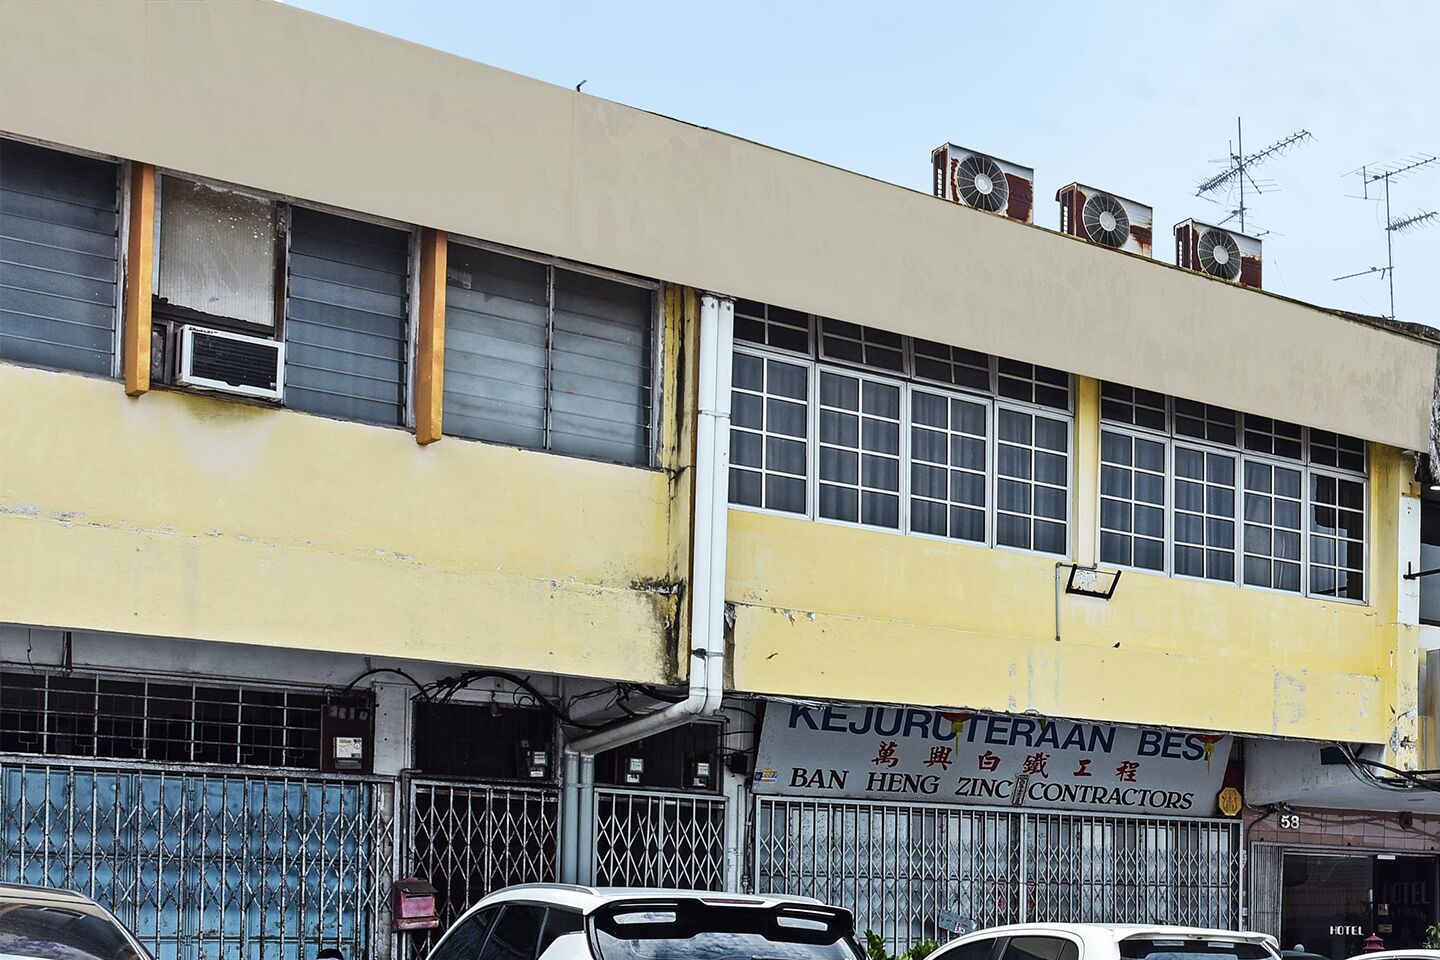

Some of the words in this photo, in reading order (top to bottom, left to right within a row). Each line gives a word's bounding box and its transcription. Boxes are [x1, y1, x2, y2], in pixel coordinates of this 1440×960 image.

[788, 706, 1116, 754] KEJURUTERAAN
[1137, 729, 1212, 761] BES
[789, 767, 849, 789] BAN
[865, 772, 941, 794] HENG
[955, 776, 1013, 799] ZINC
[1029, 782, 1194, 809] CONTRACTORS
[1280, 815, 1300, 829] 58
[1330, 925, 1365, 936] HOTEL
